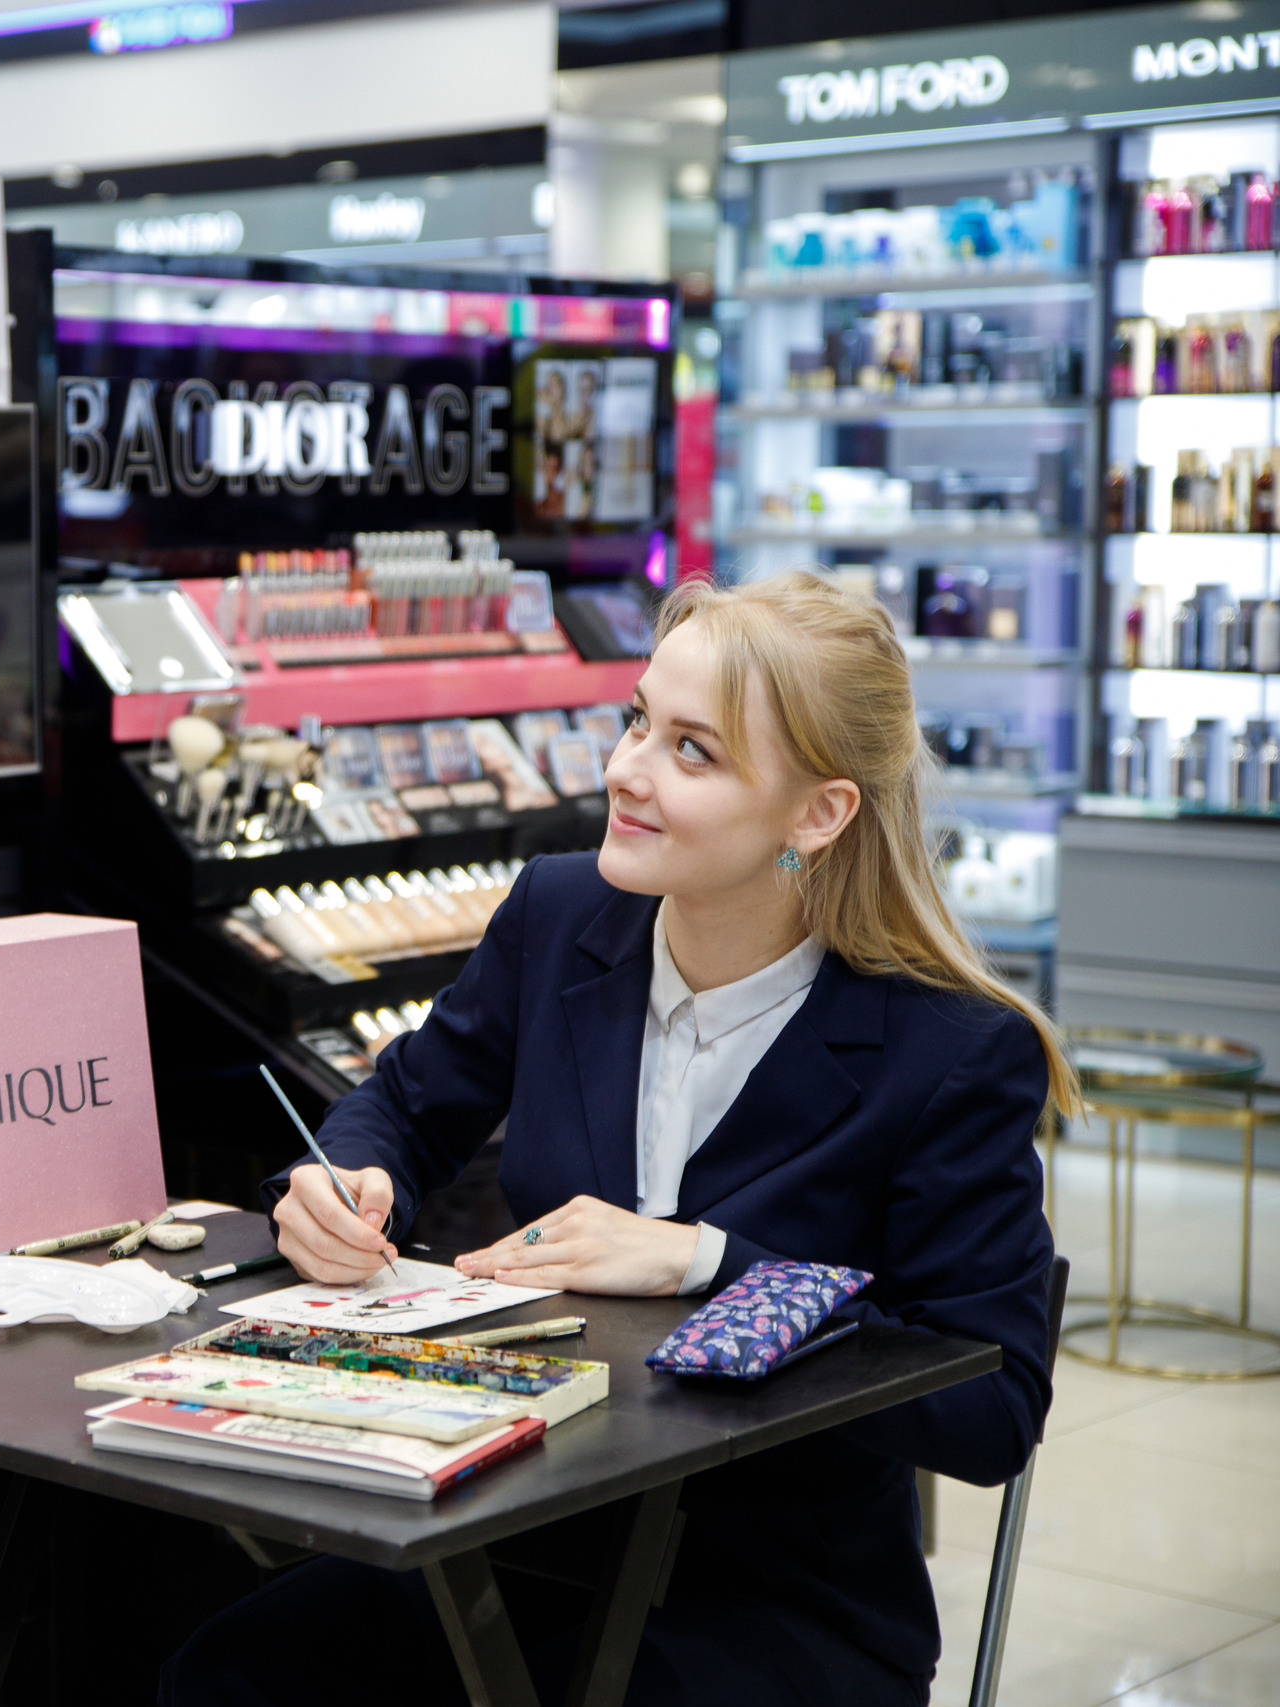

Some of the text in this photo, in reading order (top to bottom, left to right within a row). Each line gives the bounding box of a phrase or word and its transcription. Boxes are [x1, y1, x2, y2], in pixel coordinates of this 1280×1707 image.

[778, 54, 1009, 125] TOM FORD
[213, 399, 373, 476] DIOR
